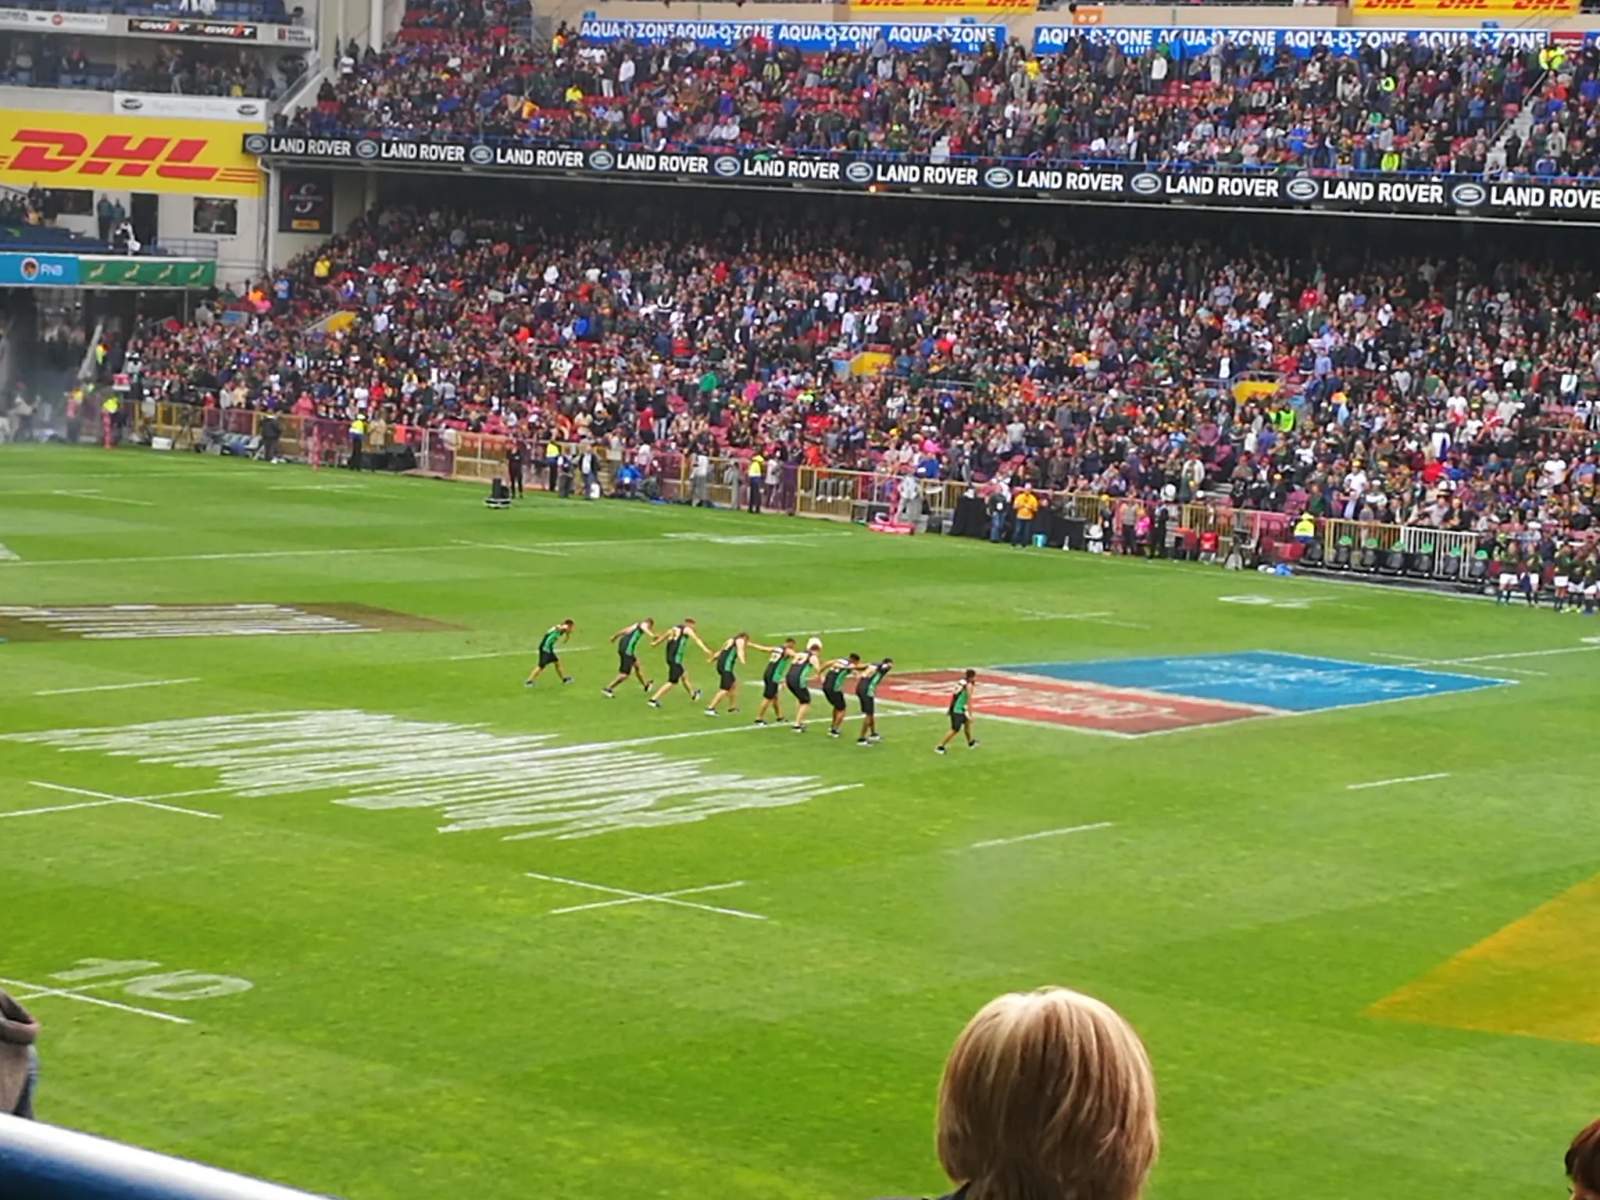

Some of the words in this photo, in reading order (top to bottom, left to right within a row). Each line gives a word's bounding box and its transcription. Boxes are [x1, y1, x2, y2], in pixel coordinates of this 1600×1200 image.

[8, 129, 220, 181] DHL
[270, 137, 306, 154] LAND
[307, 139, 351, 156] ROVER
[381, 142, 418, 159] LAND
[420, 144, 465, 162] ROVER
[496, 147, 534, 165] LAND
[536, 149, 584, 168] ROVER
[616, 153, 657, 171] LAND
[659, 155, 709, 174] ROVER
[743, 158, 785, 177] LAND
[787, 159, 840, 179] ROVER
[876, 163, 920, 183] LAND
[922, 165, 979, 186] ROVER
[1016, 170, 1063, 189] LAND
[1065, 171, 1124, 192] ROVER
[1165, 175, 1215, 194] LAND
[1217, 177, 1279, 198] ROVER
[1322, 180, 1375, 201] LAND
[1377, 182, 1444, 204] ROVER
[1490, 186, 1546, 208] LAND
